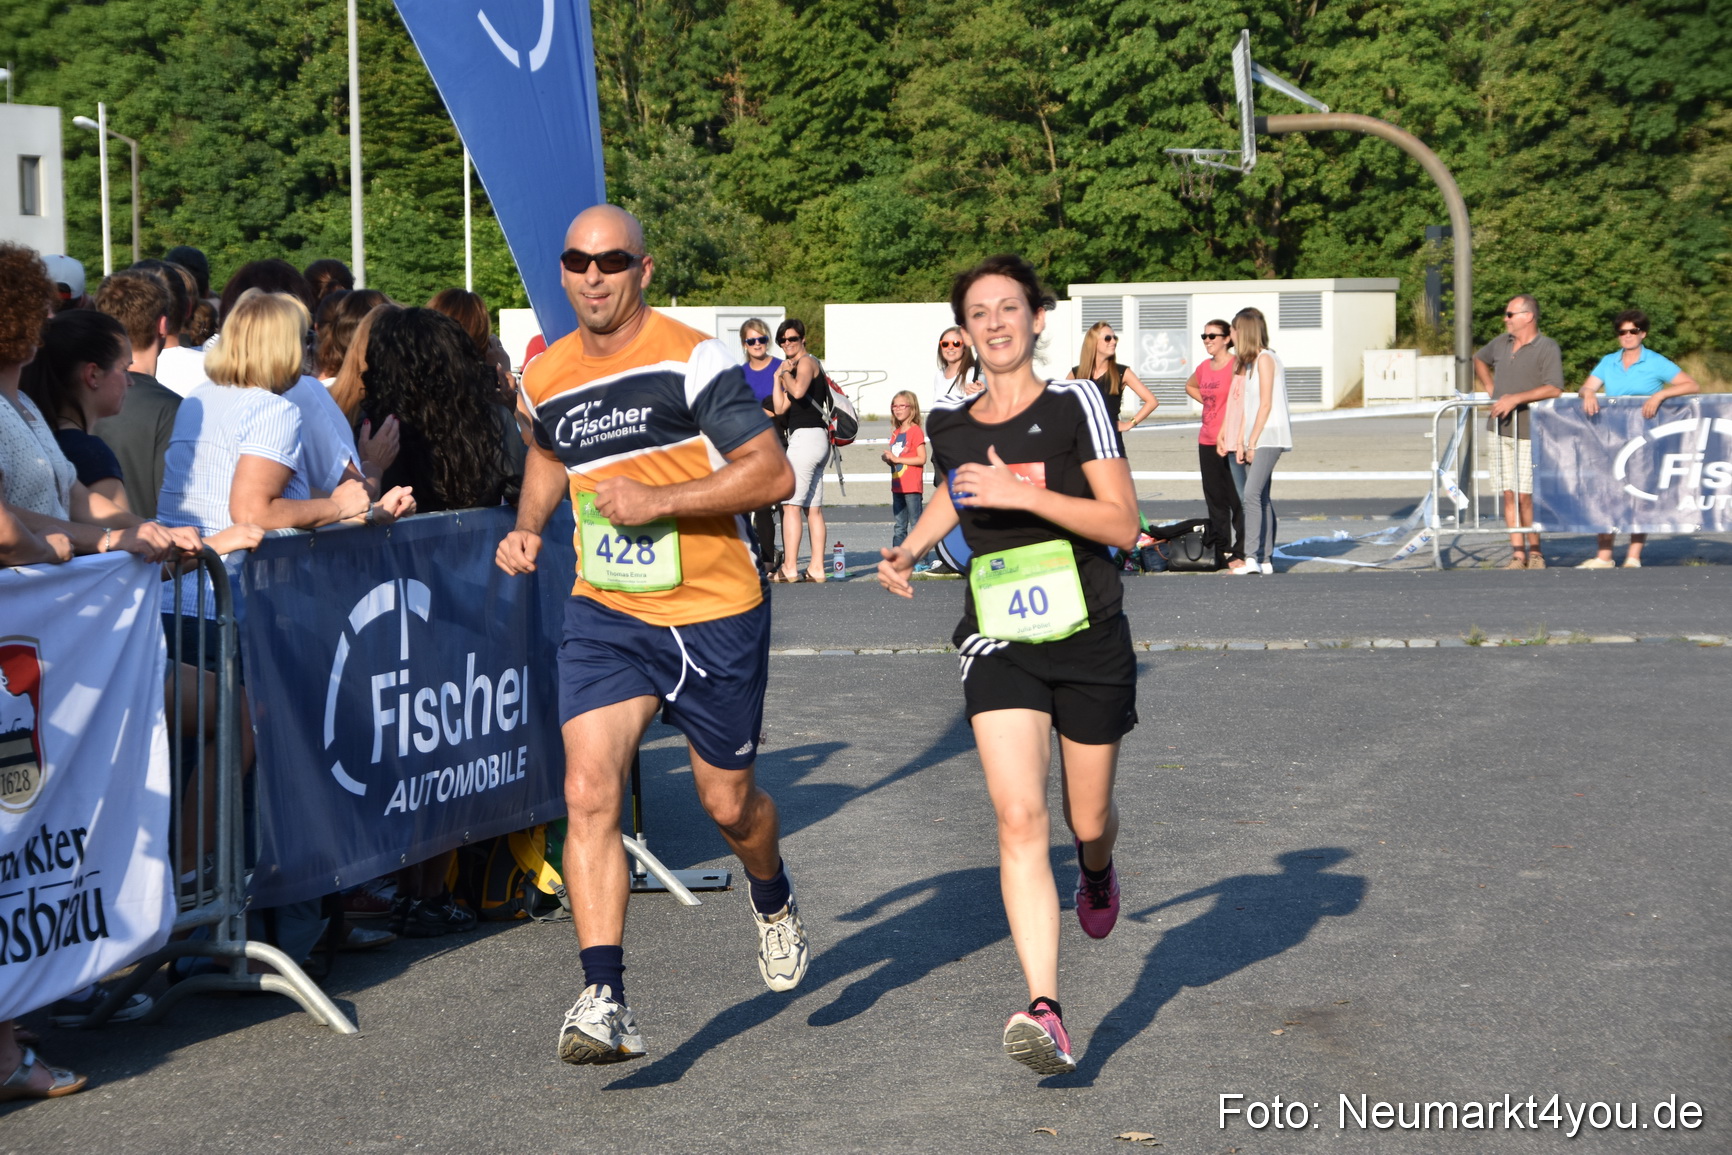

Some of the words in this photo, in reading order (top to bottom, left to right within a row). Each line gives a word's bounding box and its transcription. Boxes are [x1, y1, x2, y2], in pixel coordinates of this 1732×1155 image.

[570, 407, 652, 440] Fischer
[580, 424, 647, 447] AUTOMOBILE
[596, 533, 656, 565] 428
[1008, 585, 1049, 619] 40
[0, 768, 31, 796] 1628
[384, 745, 527, 816] AUTOMOBILE
